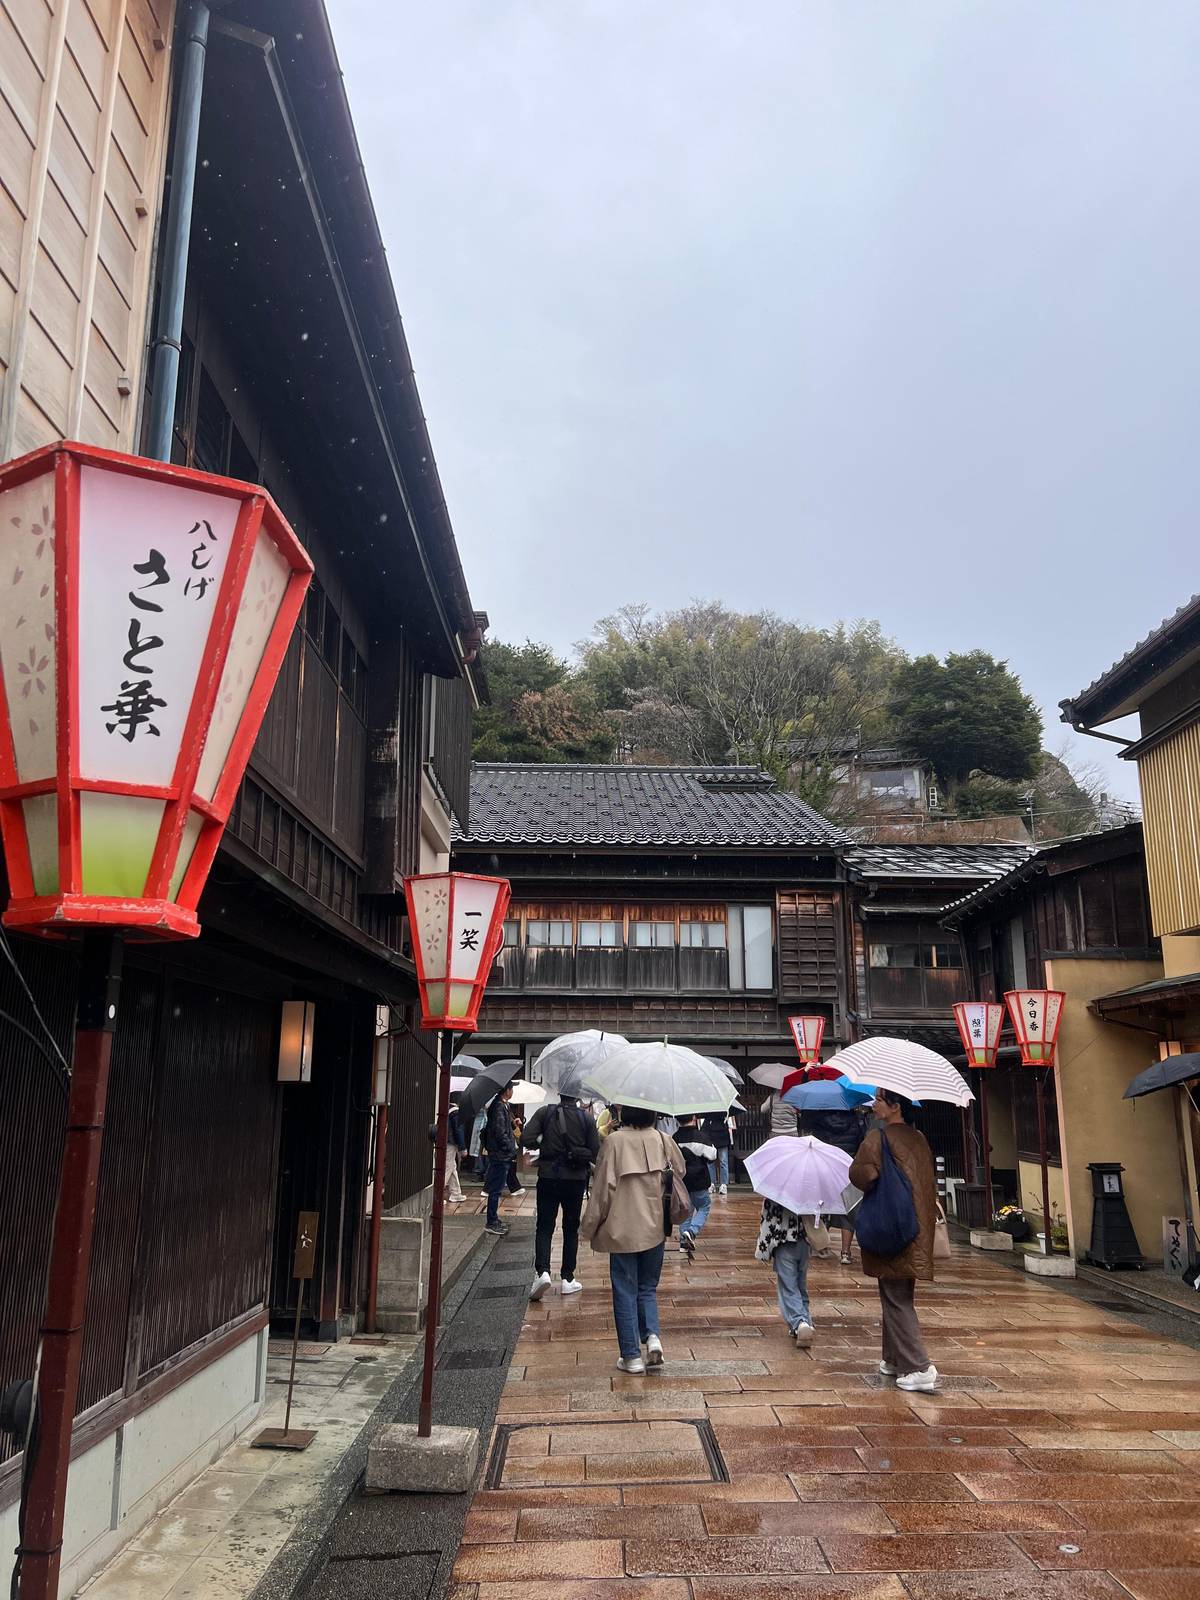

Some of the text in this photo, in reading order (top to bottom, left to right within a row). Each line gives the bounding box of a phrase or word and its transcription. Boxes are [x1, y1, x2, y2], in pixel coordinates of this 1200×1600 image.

[183, 519, 217, 601] 八しげ
[100, 548, 170, 743] さと葉
[459, 911, 482, 951] 一笑
[1027, 997, 1039, 1032] 今日香
